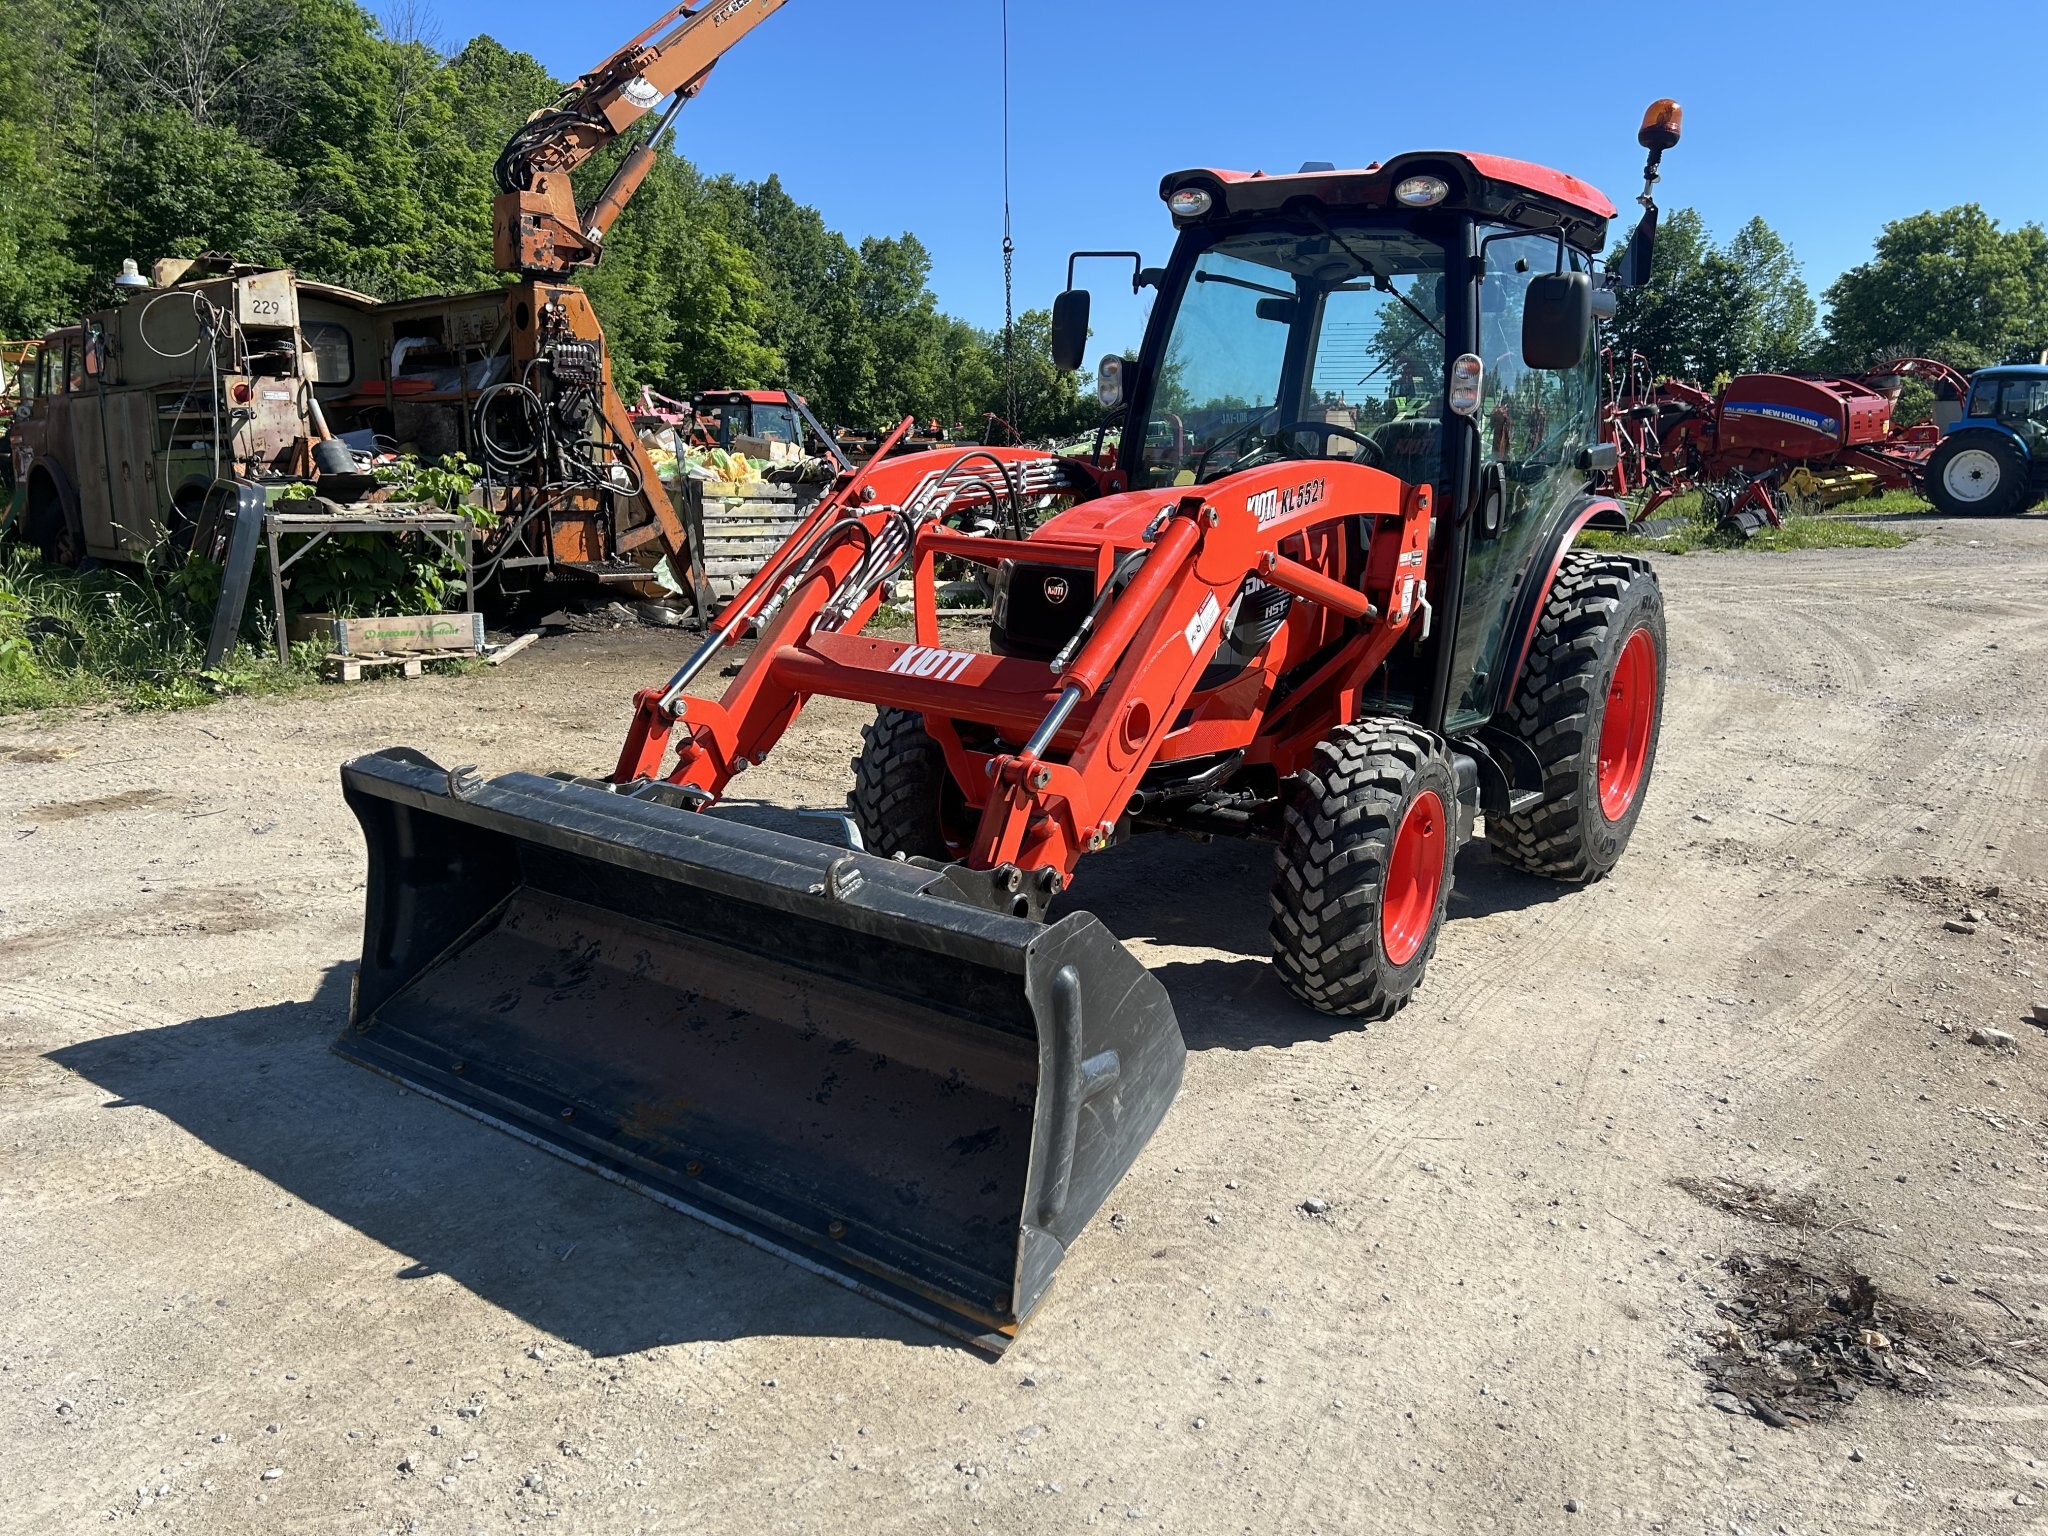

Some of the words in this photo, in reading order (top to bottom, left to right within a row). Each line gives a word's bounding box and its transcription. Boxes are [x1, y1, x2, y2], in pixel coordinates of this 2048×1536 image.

[252, 300, 279, 315] 229
[1762, 408, 1780, 417] NEW
[1781, 412, 1818, 427] HOLLAND
[1280, 488, 1295, 515] KL
[1297, 477, 1326, 508] 5521
[1264, 599, 1287, 619] HST
[887, 645, 977, 681] KIOTI
